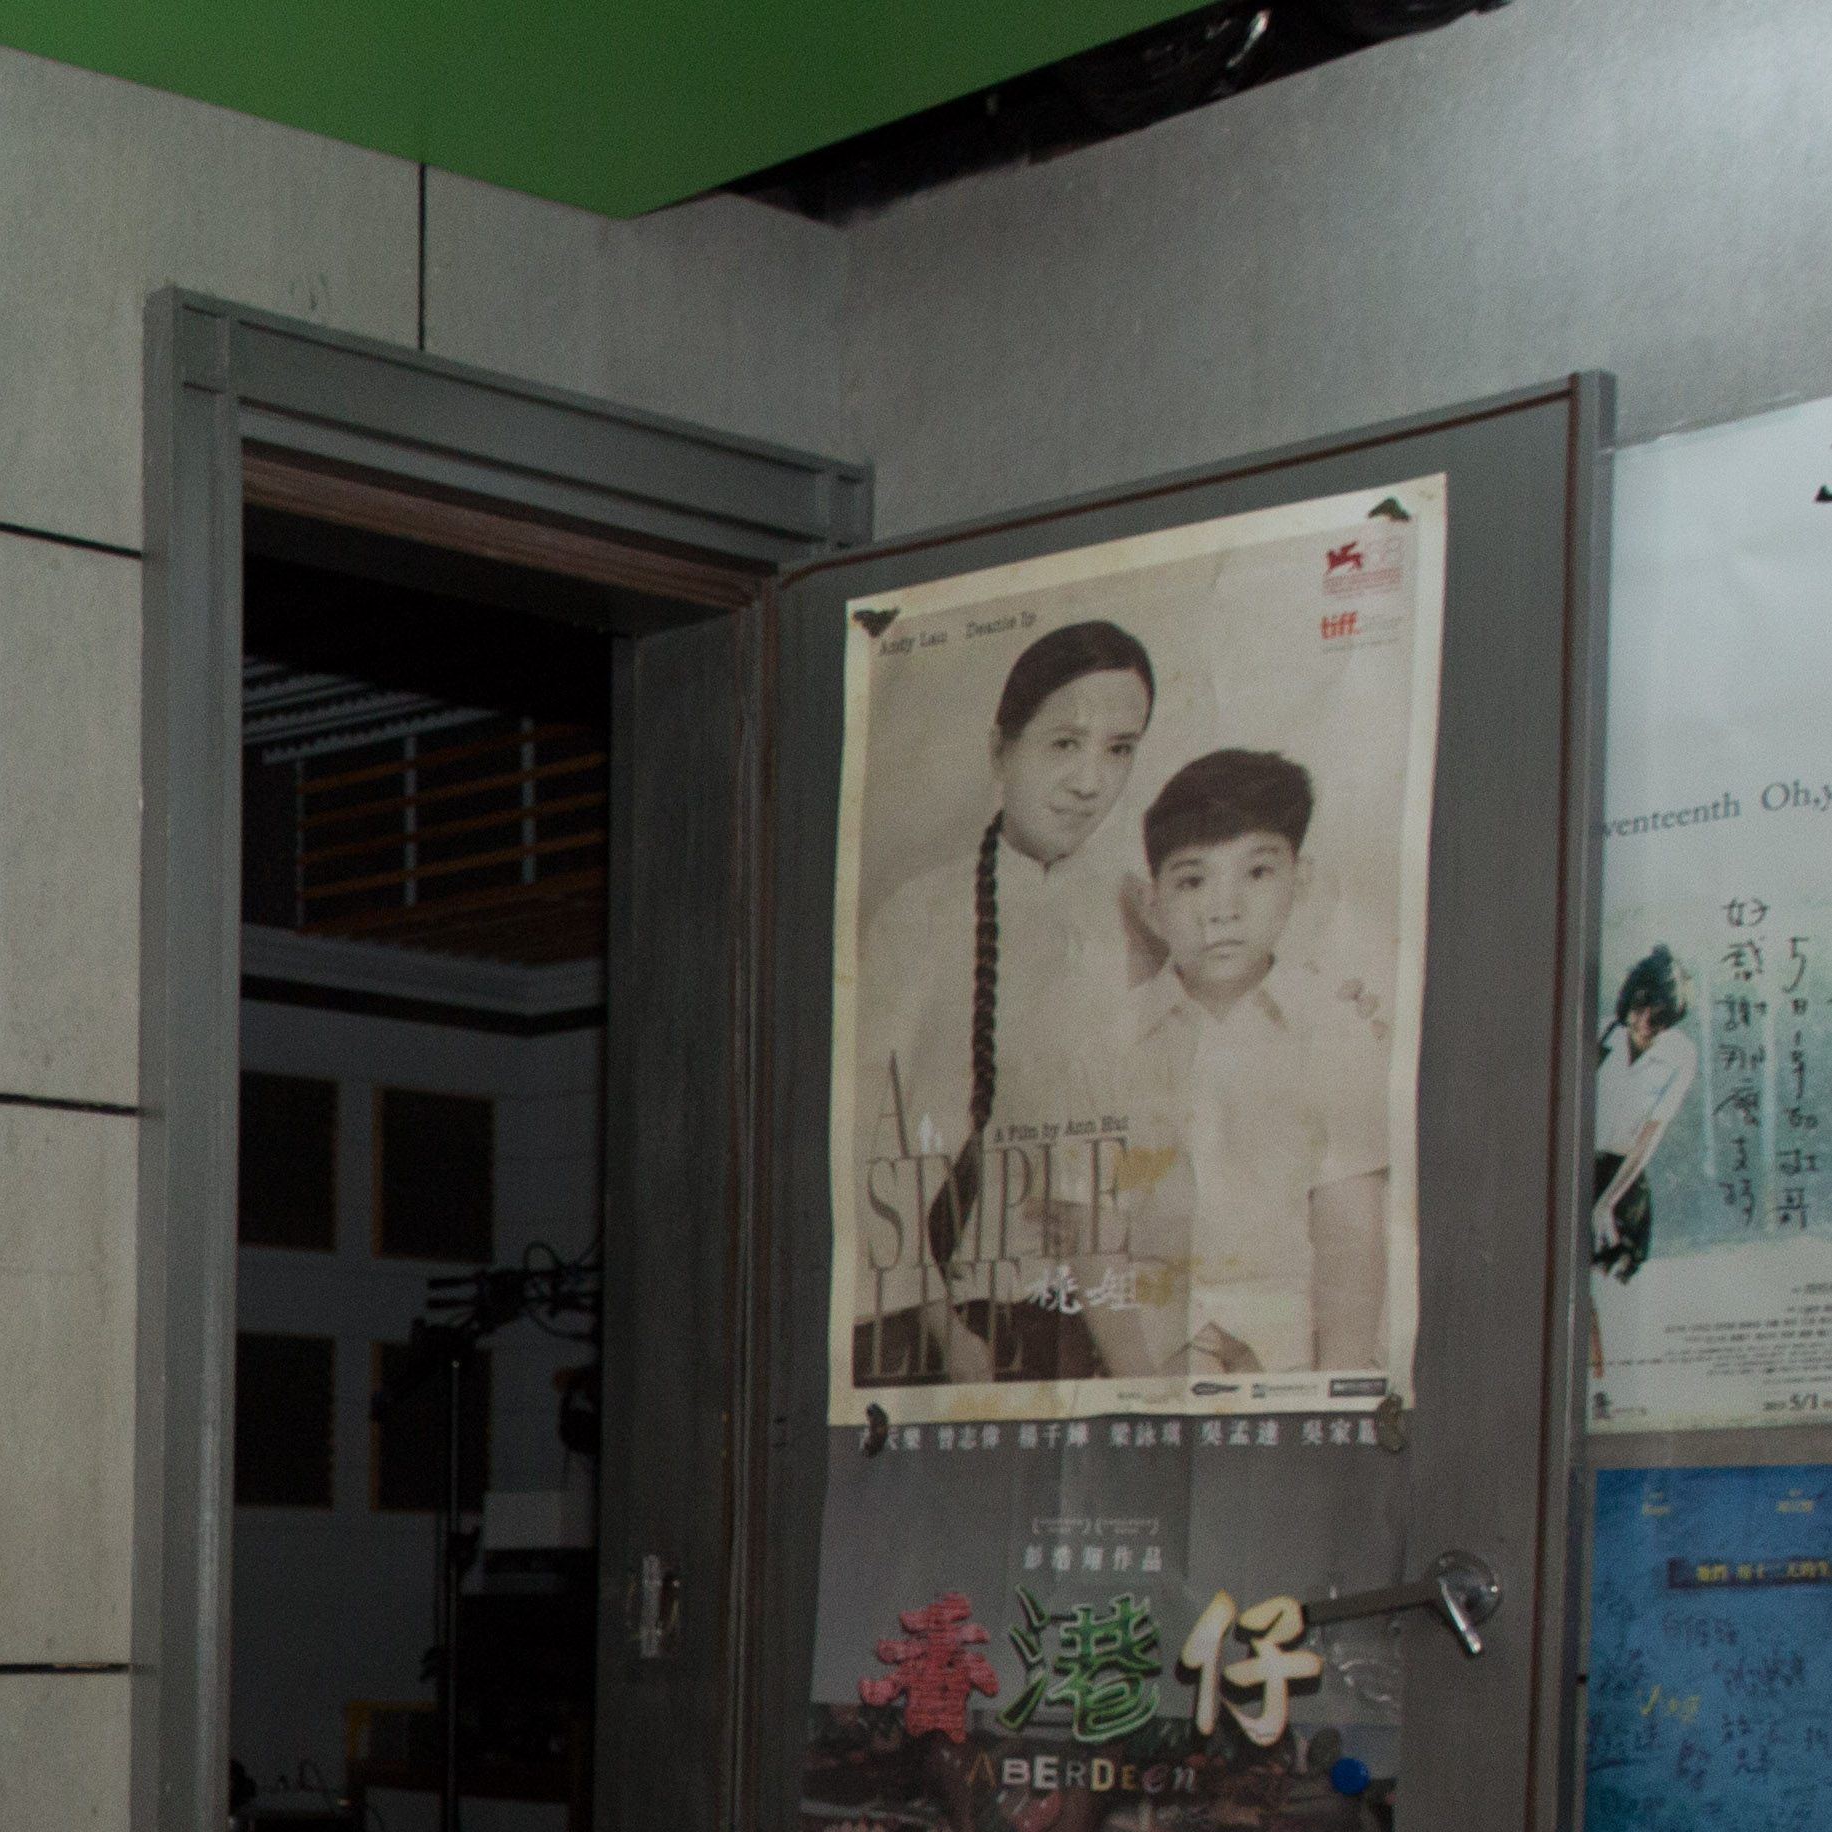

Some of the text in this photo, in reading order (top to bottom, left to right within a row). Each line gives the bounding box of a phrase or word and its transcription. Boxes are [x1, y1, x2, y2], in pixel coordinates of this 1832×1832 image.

[879, 637, 913, 657] Andy
[918, 631, 948, 648] Lau
[857, 1590, 1324, 1746] 香港仔
